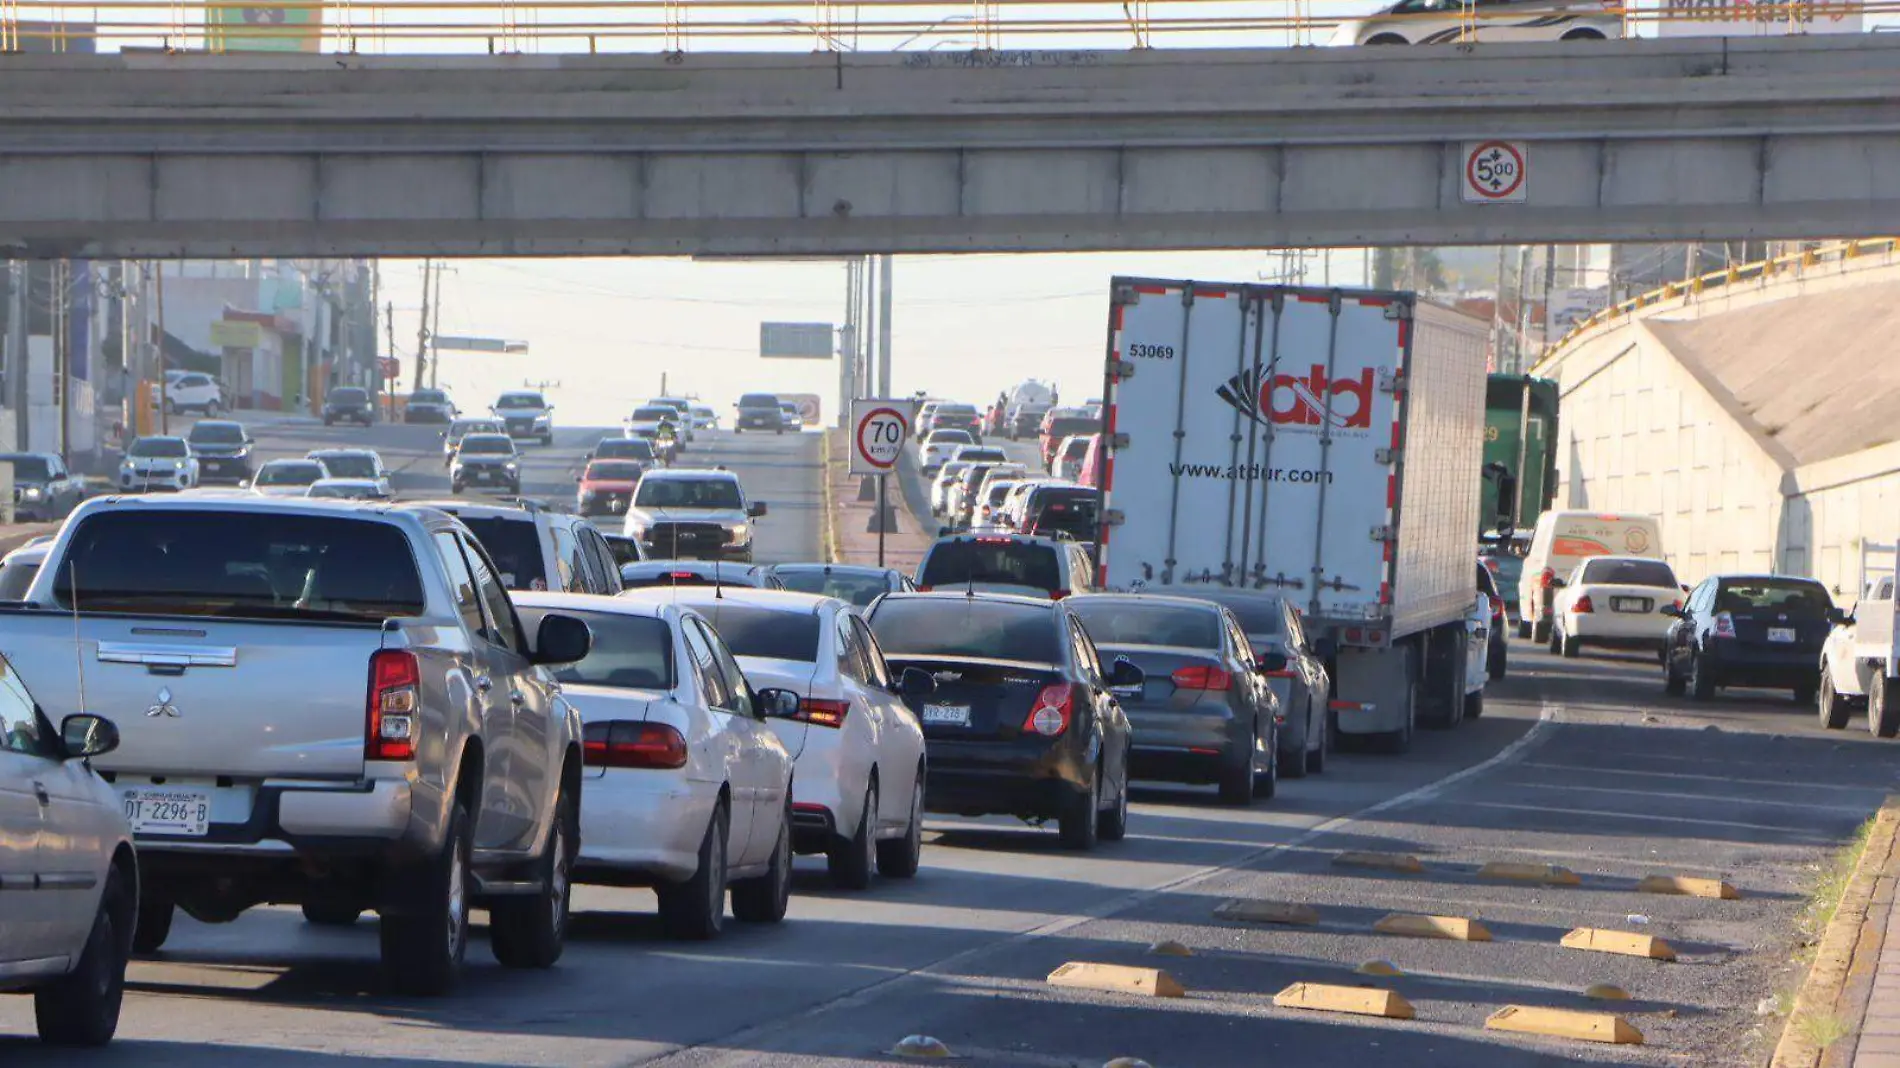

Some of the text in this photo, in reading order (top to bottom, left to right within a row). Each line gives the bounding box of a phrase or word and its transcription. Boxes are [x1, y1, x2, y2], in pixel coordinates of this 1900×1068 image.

[1130, 343, 1174, 359] 53069
[871, 421, 899, 443] 70
[1169, 461, 1333, 485] www.atdur.com
[125, 799, 207, 823] DT-2296-B
